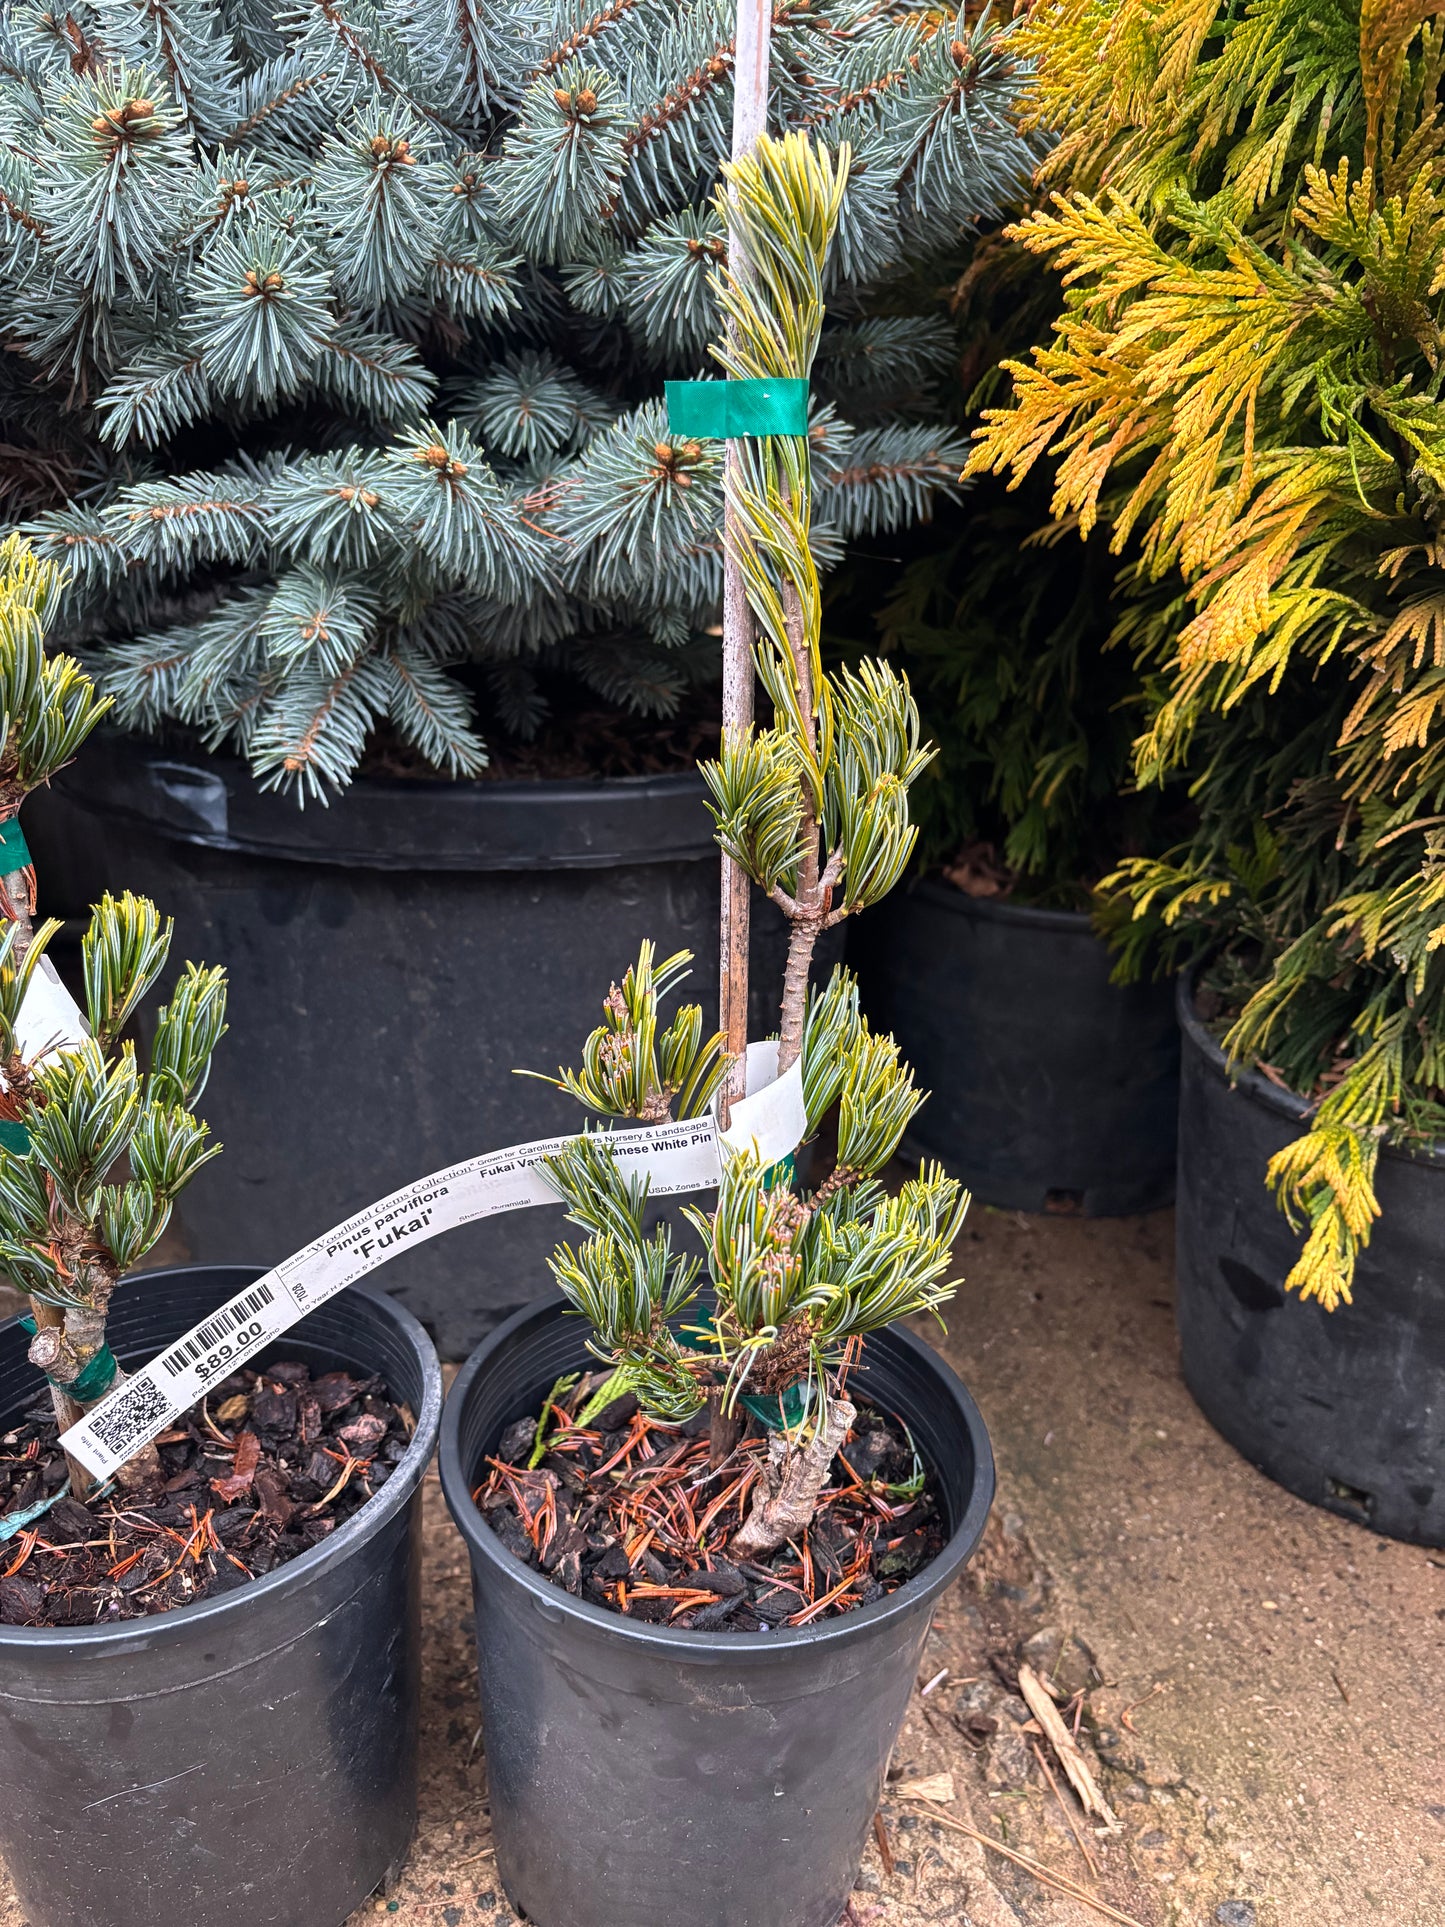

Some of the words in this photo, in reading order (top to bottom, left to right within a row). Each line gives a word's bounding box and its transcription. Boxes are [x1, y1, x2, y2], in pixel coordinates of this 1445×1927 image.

[479, 1161, 515, 1178] Fukai
[593, 1143, 649, 1157] aanese
[651, 1139, 688, 1152] White
[691, 1133, 712, 1145] Pin
[306, 1211, 372, 1253] "Woodland
[374, 1193, 409, 1214] Gems
[411, 1162, 475, 1194] Collection"
[477, 1155, 503, 1166] Grown
[504, 1150, 515, 1159] for
[518, 1142, 560, 1155] Carolina
[604, 1131, 643, 1142] Nursery
[655, 1121, 708, 1137] Landscape
[648, 1185, 674, 1194] USDA
[675, 1182, 701, 1191] Zones
[704, 1178, 718, 1186] 5-8
[326, 1226, 371, 1258] Pinus
[374, 1186, 449, 1230] parviflora
[353, 1207, 433, 1259] 'Fukai'
[292, 1282, 309, 1302] 7028
[301, 1304, 311, 1313] 10
[311, 1290, 329, 1304] Year
[344, 1273, 354, 1282] W
[191, 1385, 206, 1398] Pot
[243, 1347, 254, 1357] on
[254, 1327, 280, 1348] mugho
[194, 1321, 262, 1379] $89.00
[80, 1435, 93, 1448] Info
[93, 1448, 108, 1465] Plant
